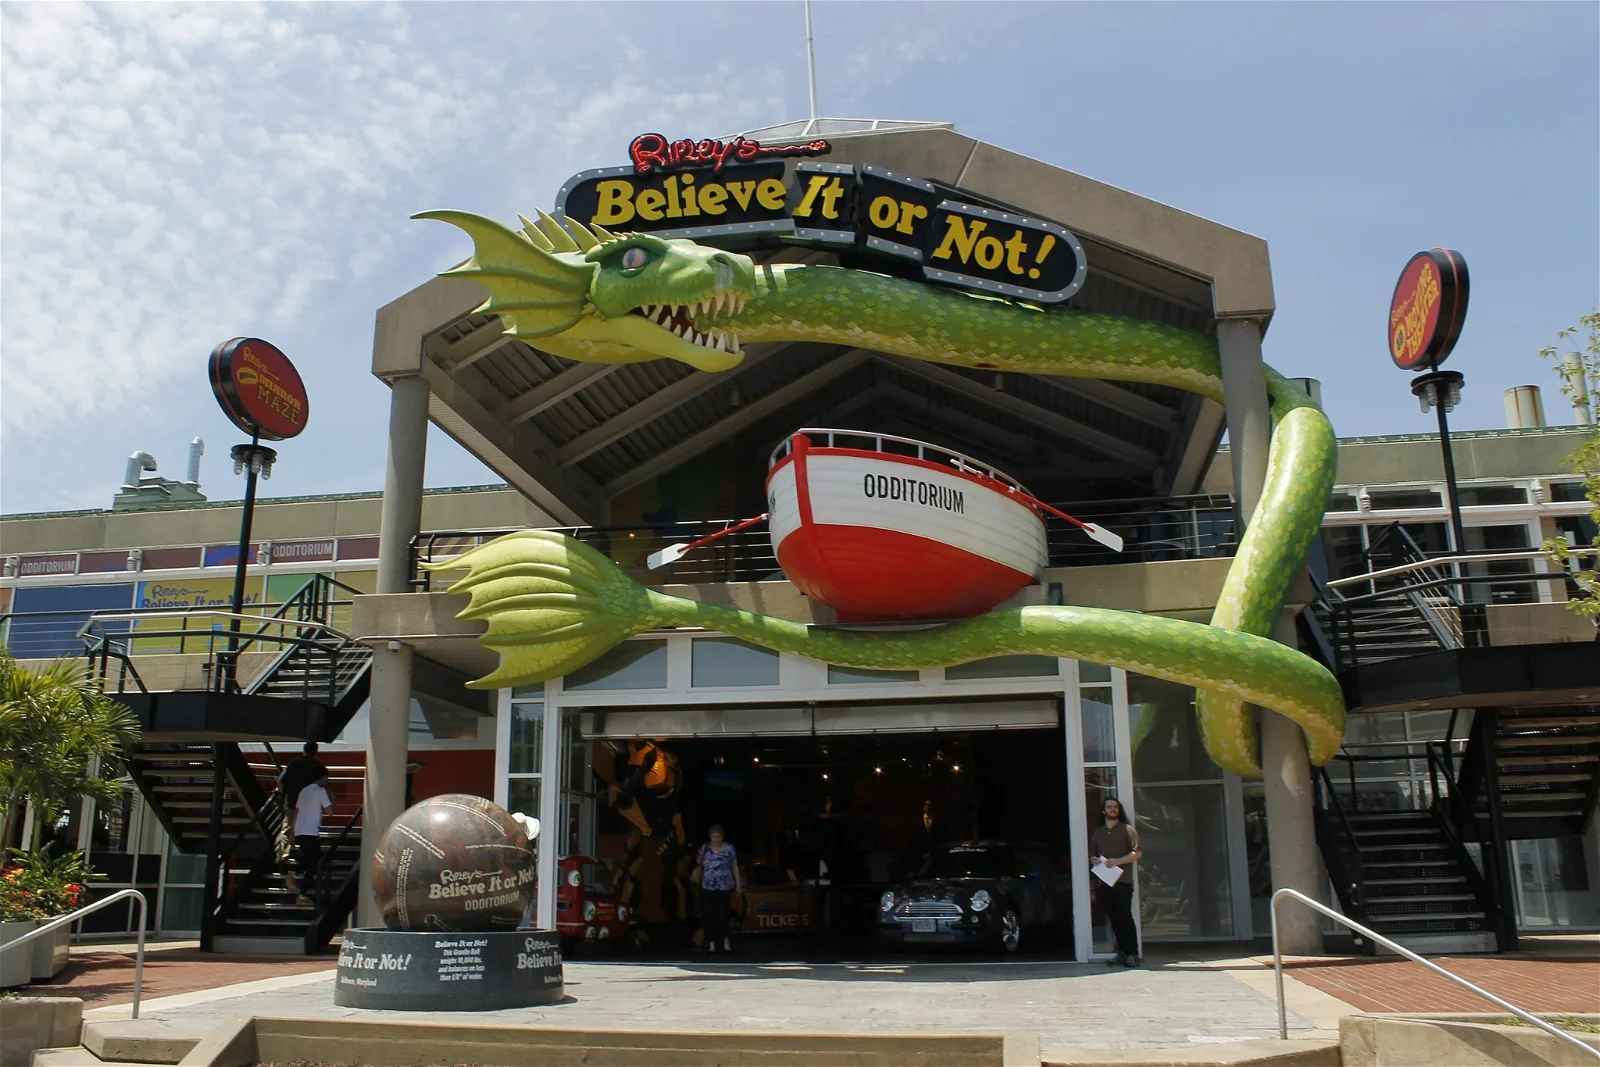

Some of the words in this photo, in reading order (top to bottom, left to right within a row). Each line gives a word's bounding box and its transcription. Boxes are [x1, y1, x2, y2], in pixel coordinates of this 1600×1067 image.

[590, 173, 787, 226] Believe
[791, 175, 845, 220] It
[868, 195, 928, 235] or
[931, 214, 1056, 280] Not!
[257, 384, 301, 425] MAZE
[864, 473, 965, 515] ODDITORIUM
[272, 542, 333, 558] ODDITORIUM
[20, 560, 76, 575] ODDITORIUM
[428, 880, 485, 899] Believe
[488, 876, 503, 892] It
[503, 878, 517, 889] or
[465, 891, 520, 911] ODDITORIUM
[756, 913, 809, 928] TICKETS
[353, 952, 364, 968] It
[364, 957, 378, 969] or
[378, 953, 412, 971] Not!
[516, 953, 553, 969] Believe
